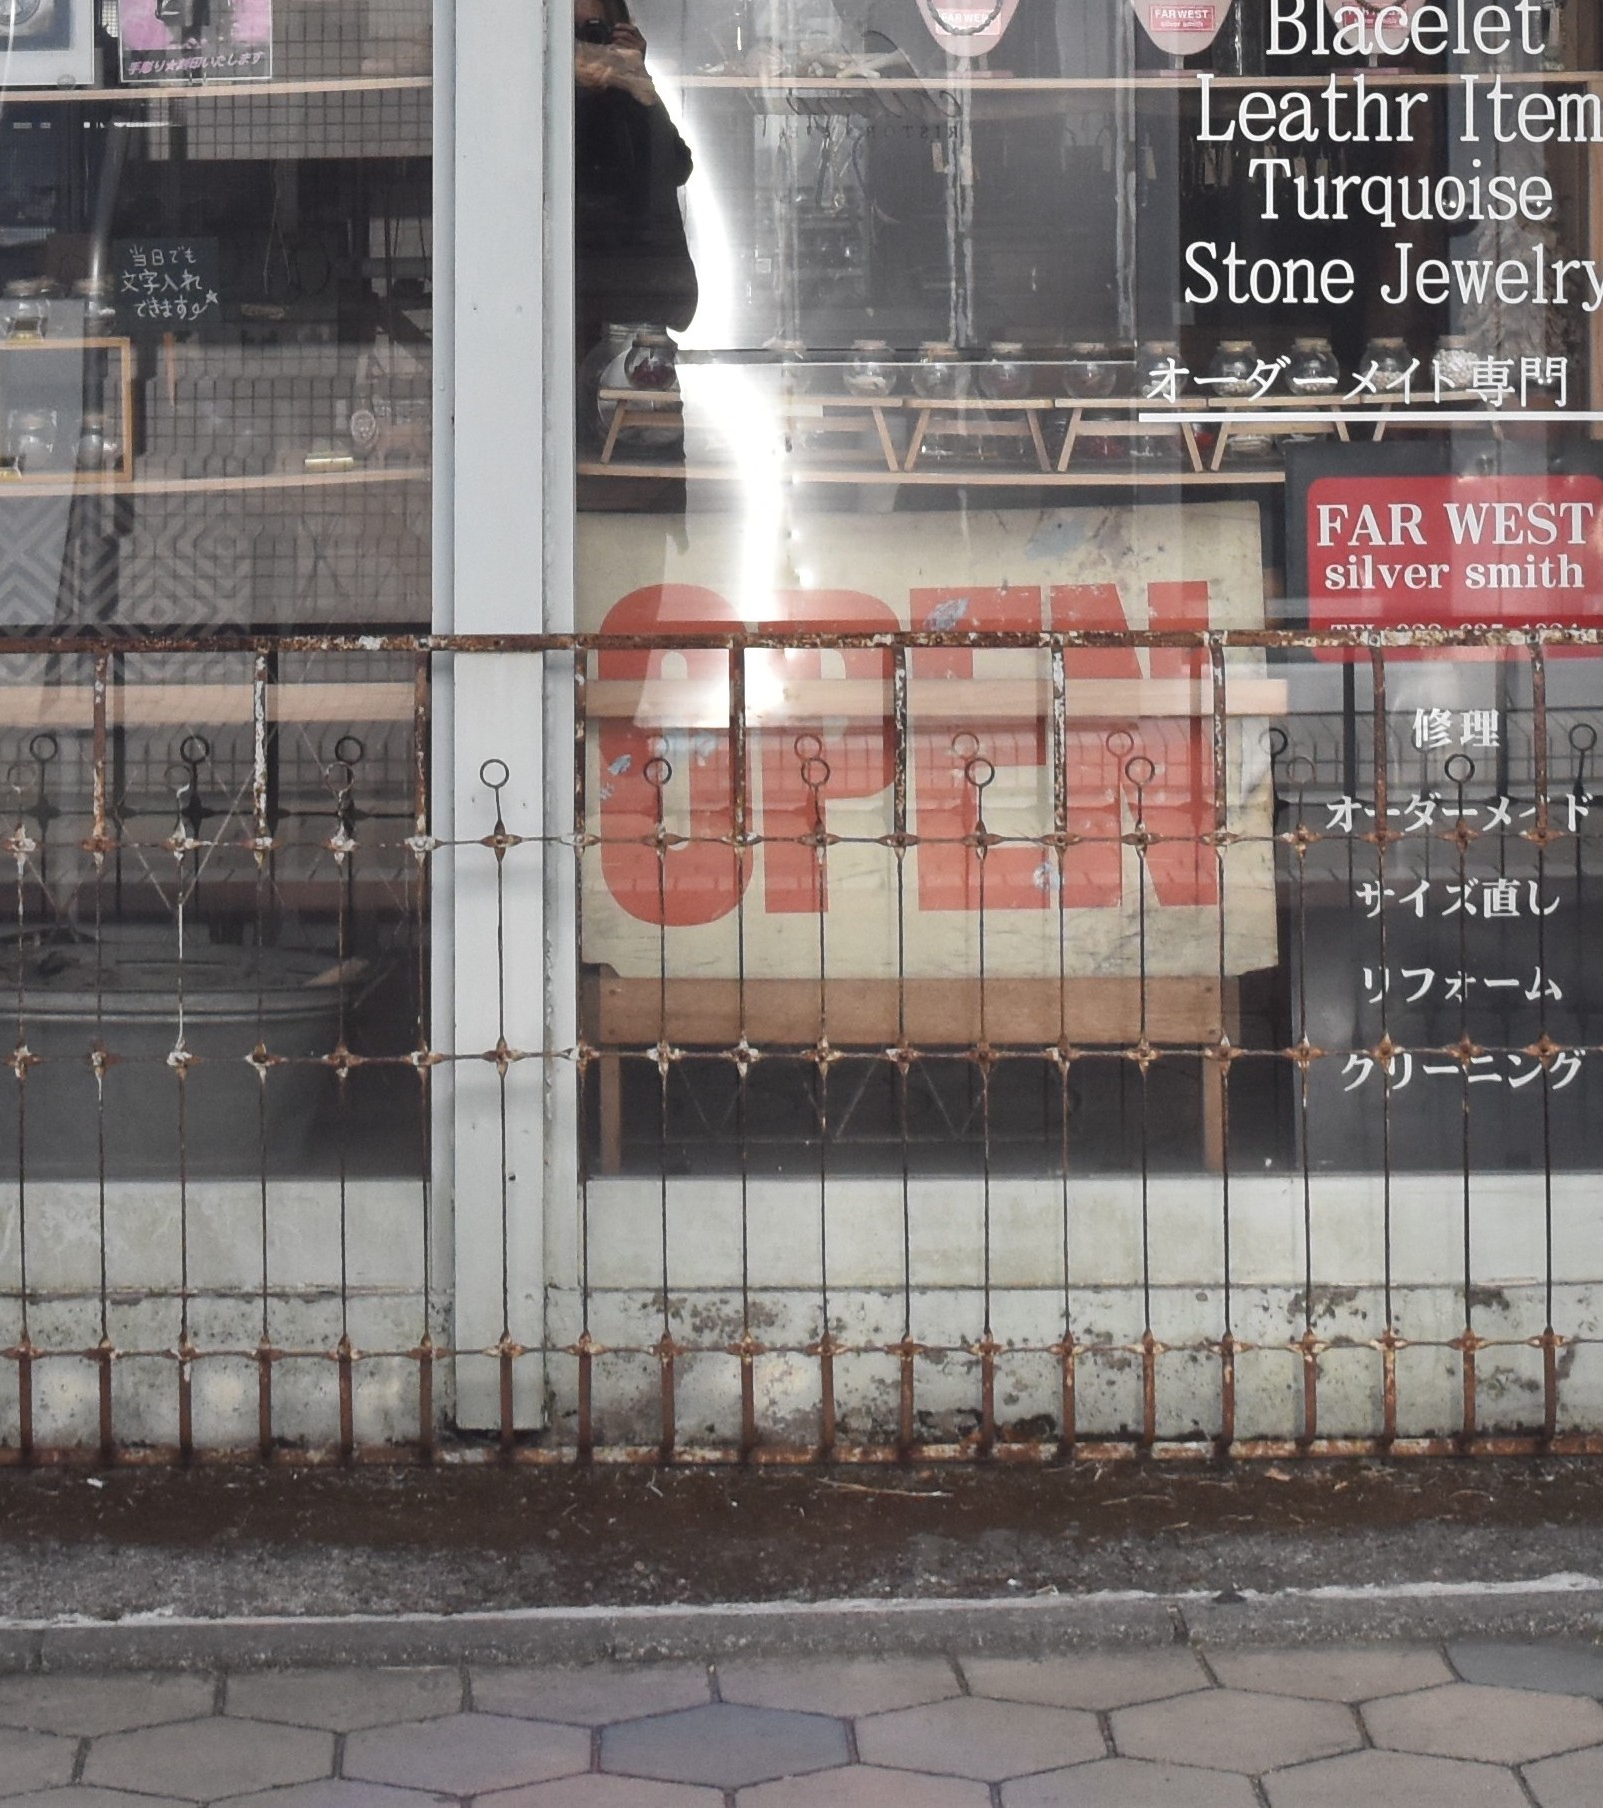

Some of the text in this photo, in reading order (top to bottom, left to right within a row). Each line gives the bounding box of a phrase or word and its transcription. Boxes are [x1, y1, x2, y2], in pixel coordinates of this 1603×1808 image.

[1196, 73, 1603, 143] Leathr Item
[1248, 158, 1553, 228] Turquoise
[129, 245, 197, 267] 当日でも
[1184, 241, 1355, 304] Stone
[121, 268, 203, 295] 文字入れ
[1317, 502, 1594, 546] FAR WEST
[1325, 553, 1585, 590] silver smith
[1412, 707, 1500, 749] 修理
[598, 580, 1219, 928] OPEN
[1355, 878, 1560, 919] サイズ直し
[1361, 965, 1563, 1004] リフォーム
[1340, 1049, 1586, 1092] クリーニング
